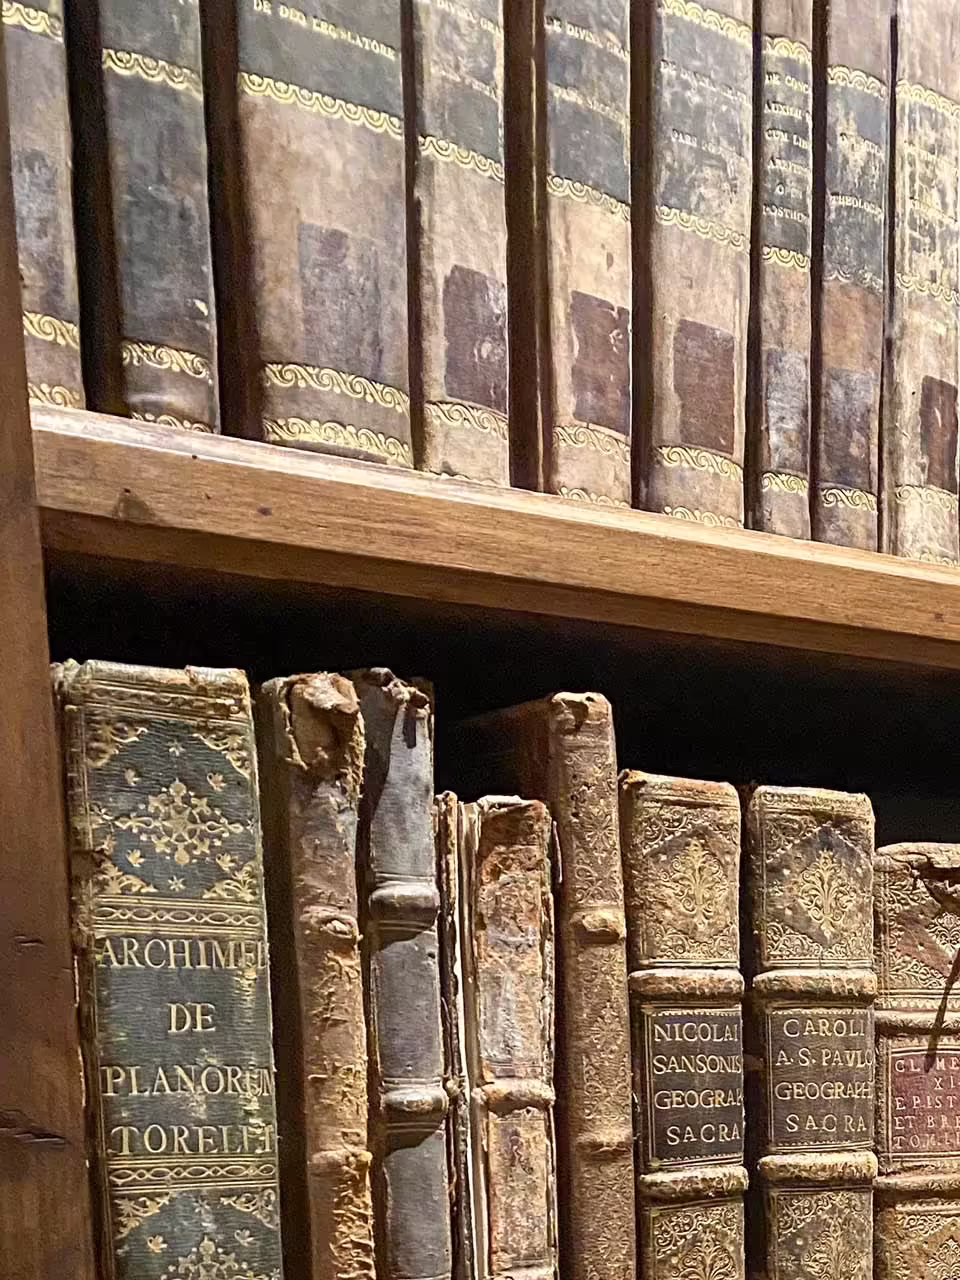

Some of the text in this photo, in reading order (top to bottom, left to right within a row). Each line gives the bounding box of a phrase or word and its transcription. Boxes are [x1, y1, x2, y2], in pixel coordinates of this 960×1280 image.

[167, 1002, 216, 1033] DE
[654, 1022, 738, 1042] NICOLAI
[783, 1018, 865, 1038] CAROLI
[653, 1055, 742, 1075] SANSONIS
[786, 1113, 868, 1133] SACRA
[893, 1115, 917, 1130] ET
[667, 1123, 741, 1145] SACRA
